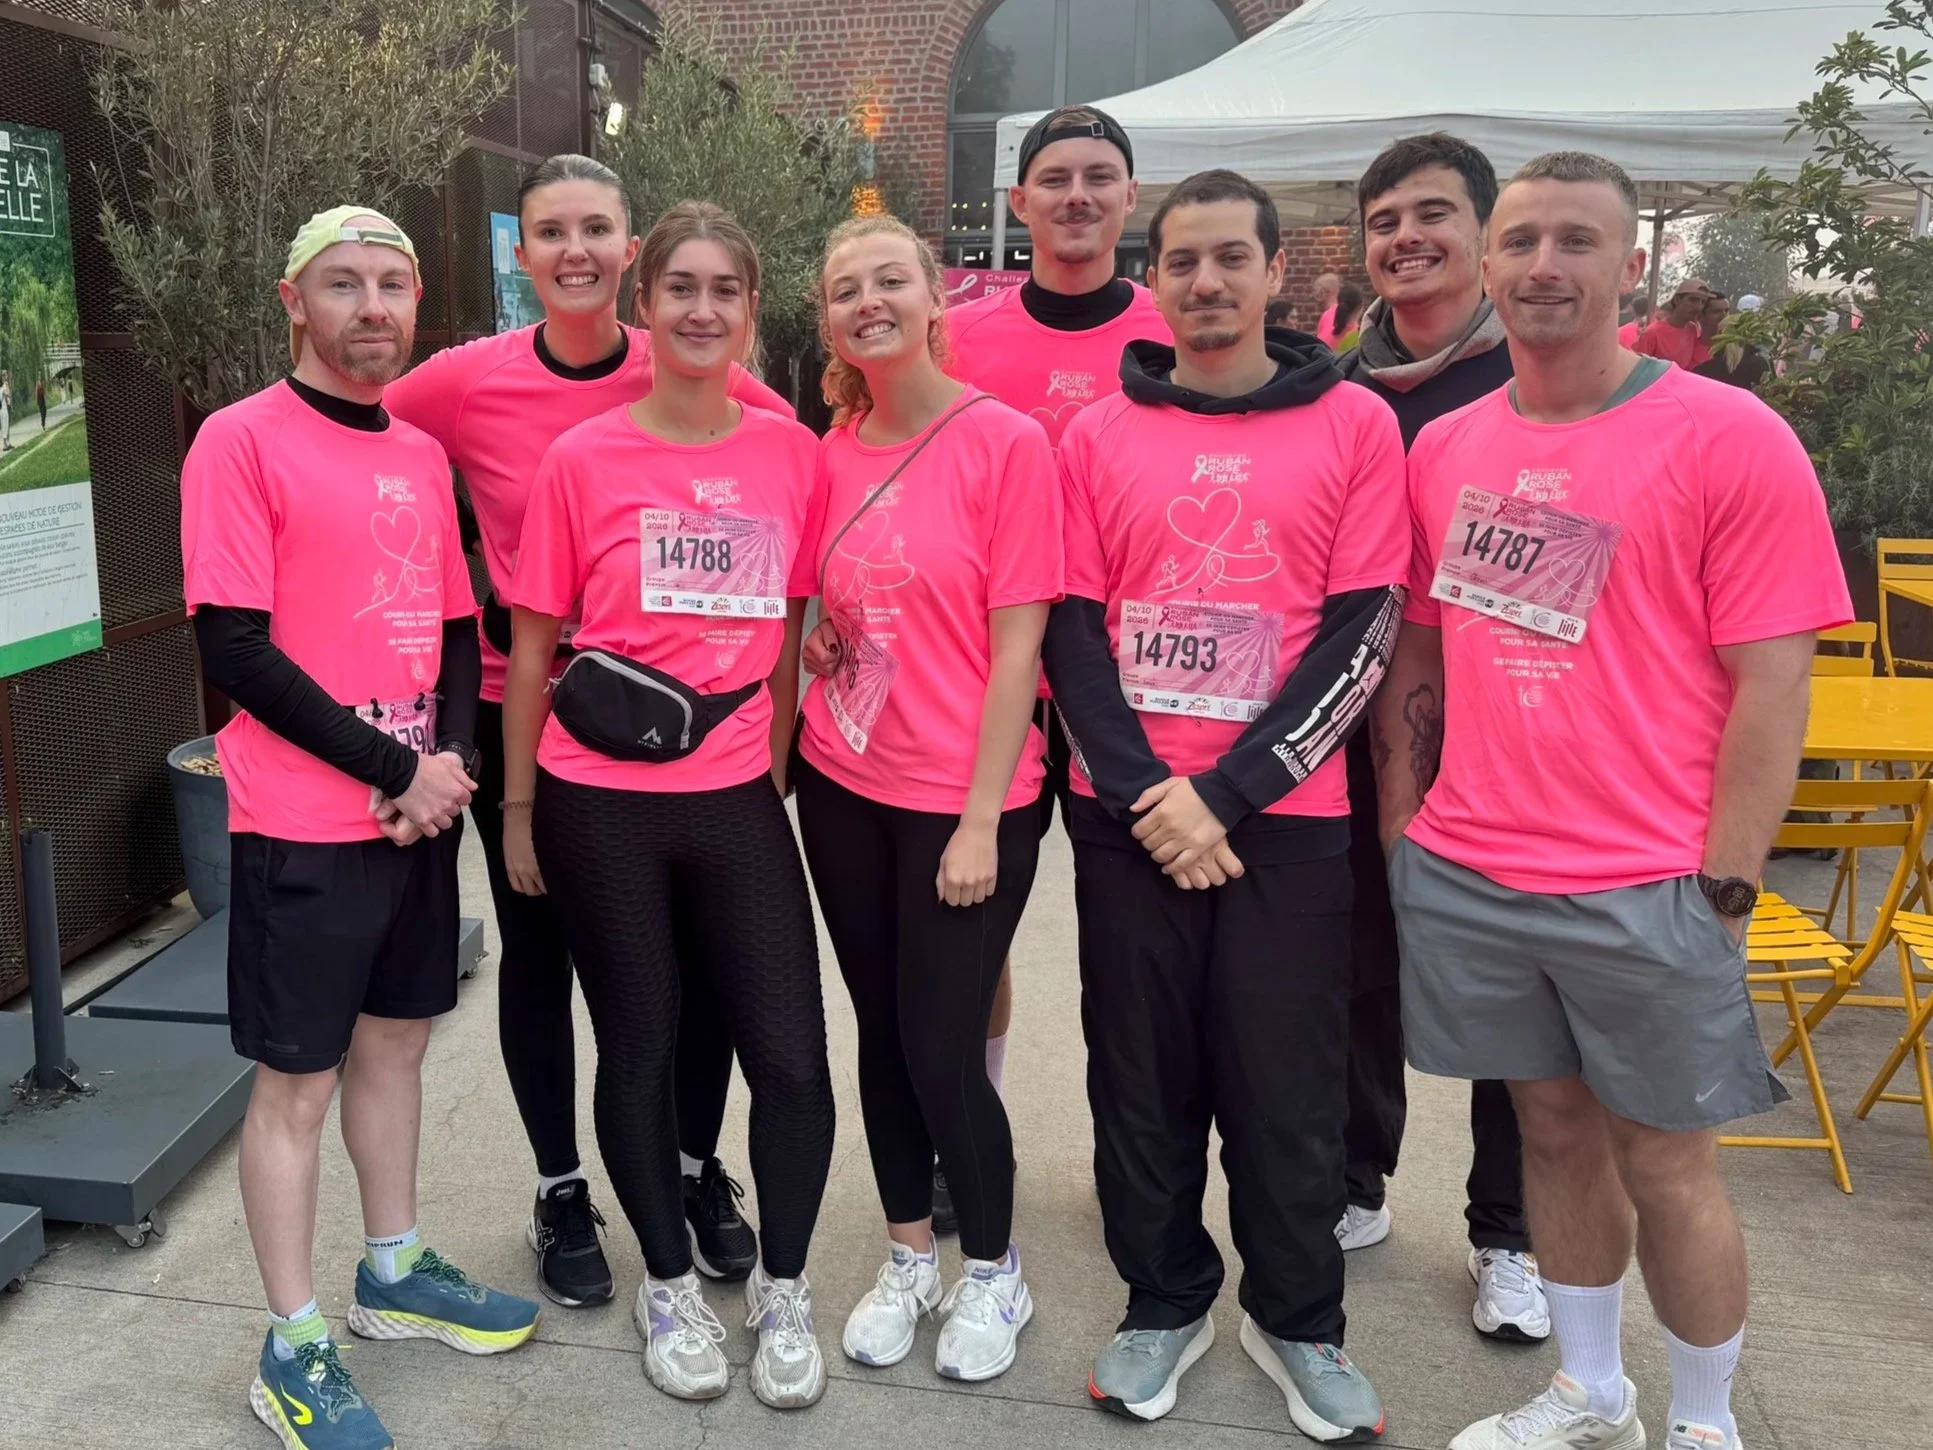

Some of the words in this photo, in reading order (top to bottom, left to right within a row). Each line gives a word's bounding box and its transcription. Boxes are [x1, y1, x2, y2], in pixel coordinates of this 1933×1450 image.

[15, 159, 39, 189] LA
[1530, 472, 1571, 481] RUBAN
[1529, 480, 1561, 489] ROSE
[1463, 491, 1490, 504] 04/10
[644, 512, 669, 521] 04/10
[1462, 520, 1546, 575] 14787
[656, 536, 732, 573] 14788
[1126, 605, 1152, 615] 04/10
[1216, 602, 1260, 610] MARCHER
[1133, 630, 1218, 673] 14793
[974, 1265, 993, 1274] NIKE
[1673, 1424, 1688, 1434] NB
